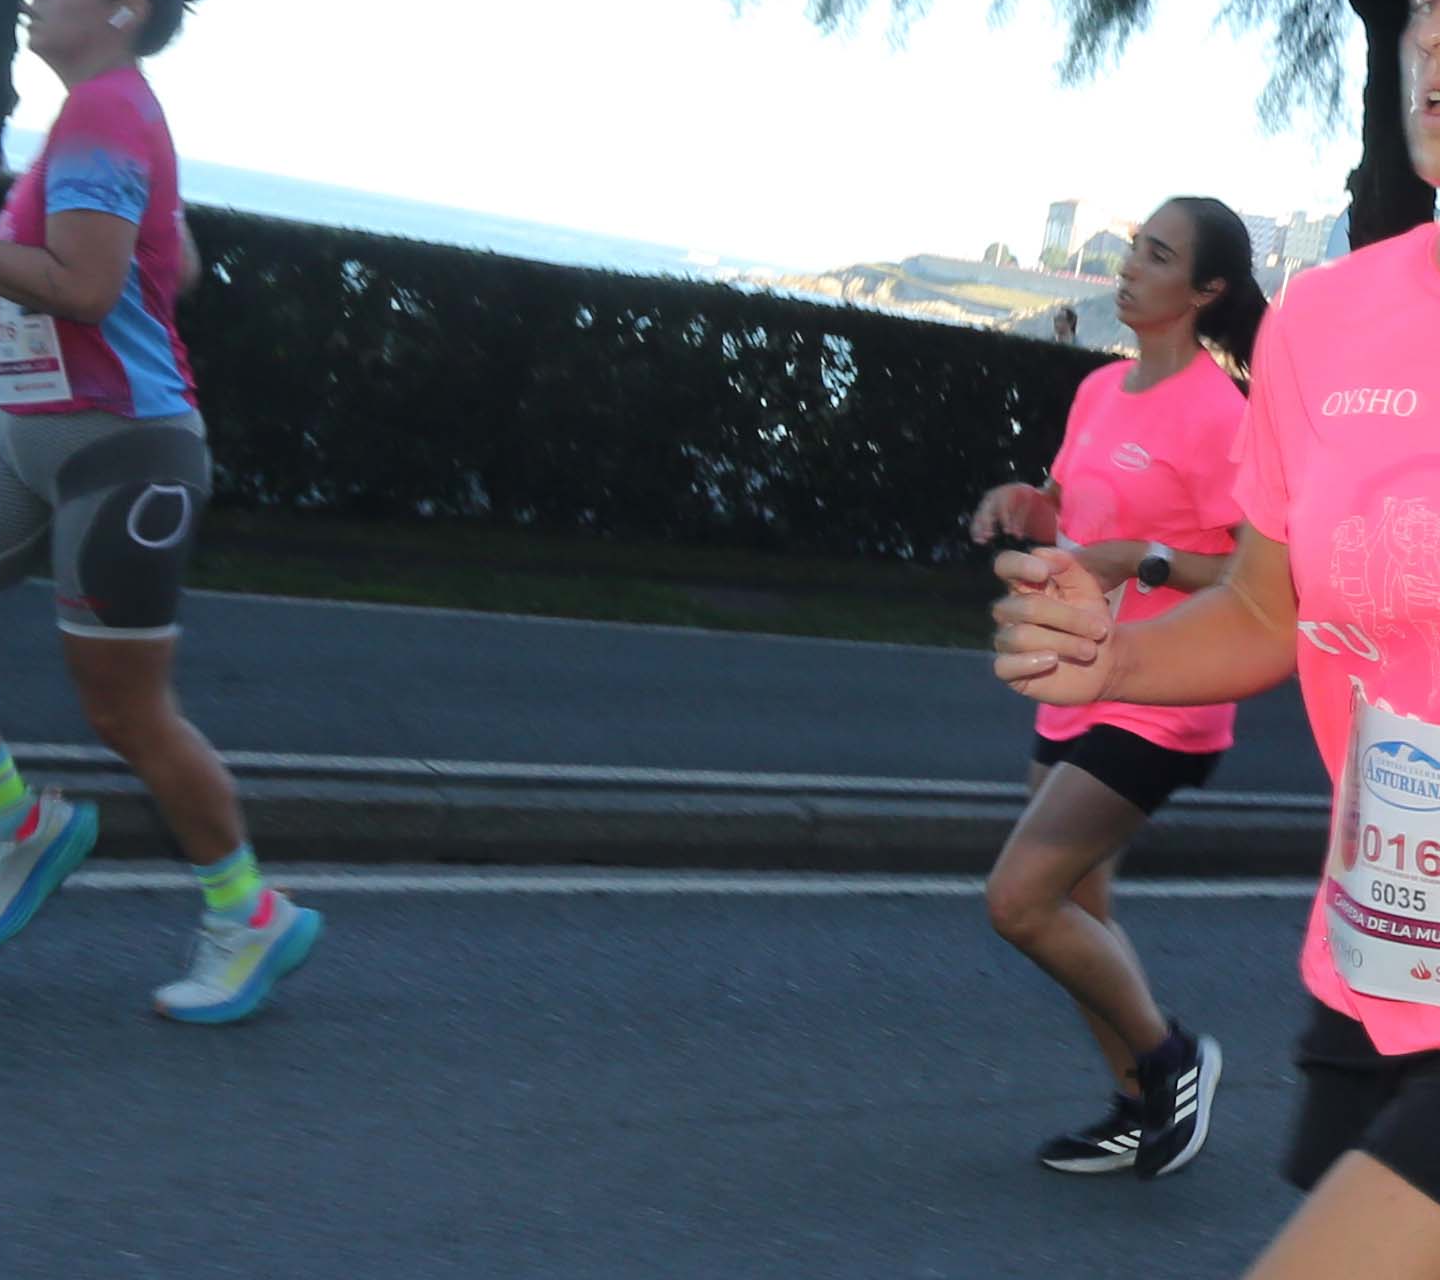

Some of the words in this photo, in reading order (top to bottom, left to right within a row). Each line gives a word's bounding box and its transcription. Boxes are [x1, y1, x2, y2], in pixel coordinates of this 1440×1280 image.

[1321, 387, 1418, 417] OYSHO
[1371, 880, 1427, 912] 6035
[1367, 916, 1390, 933] DE
[1390, 922, 1412, 939] LA
